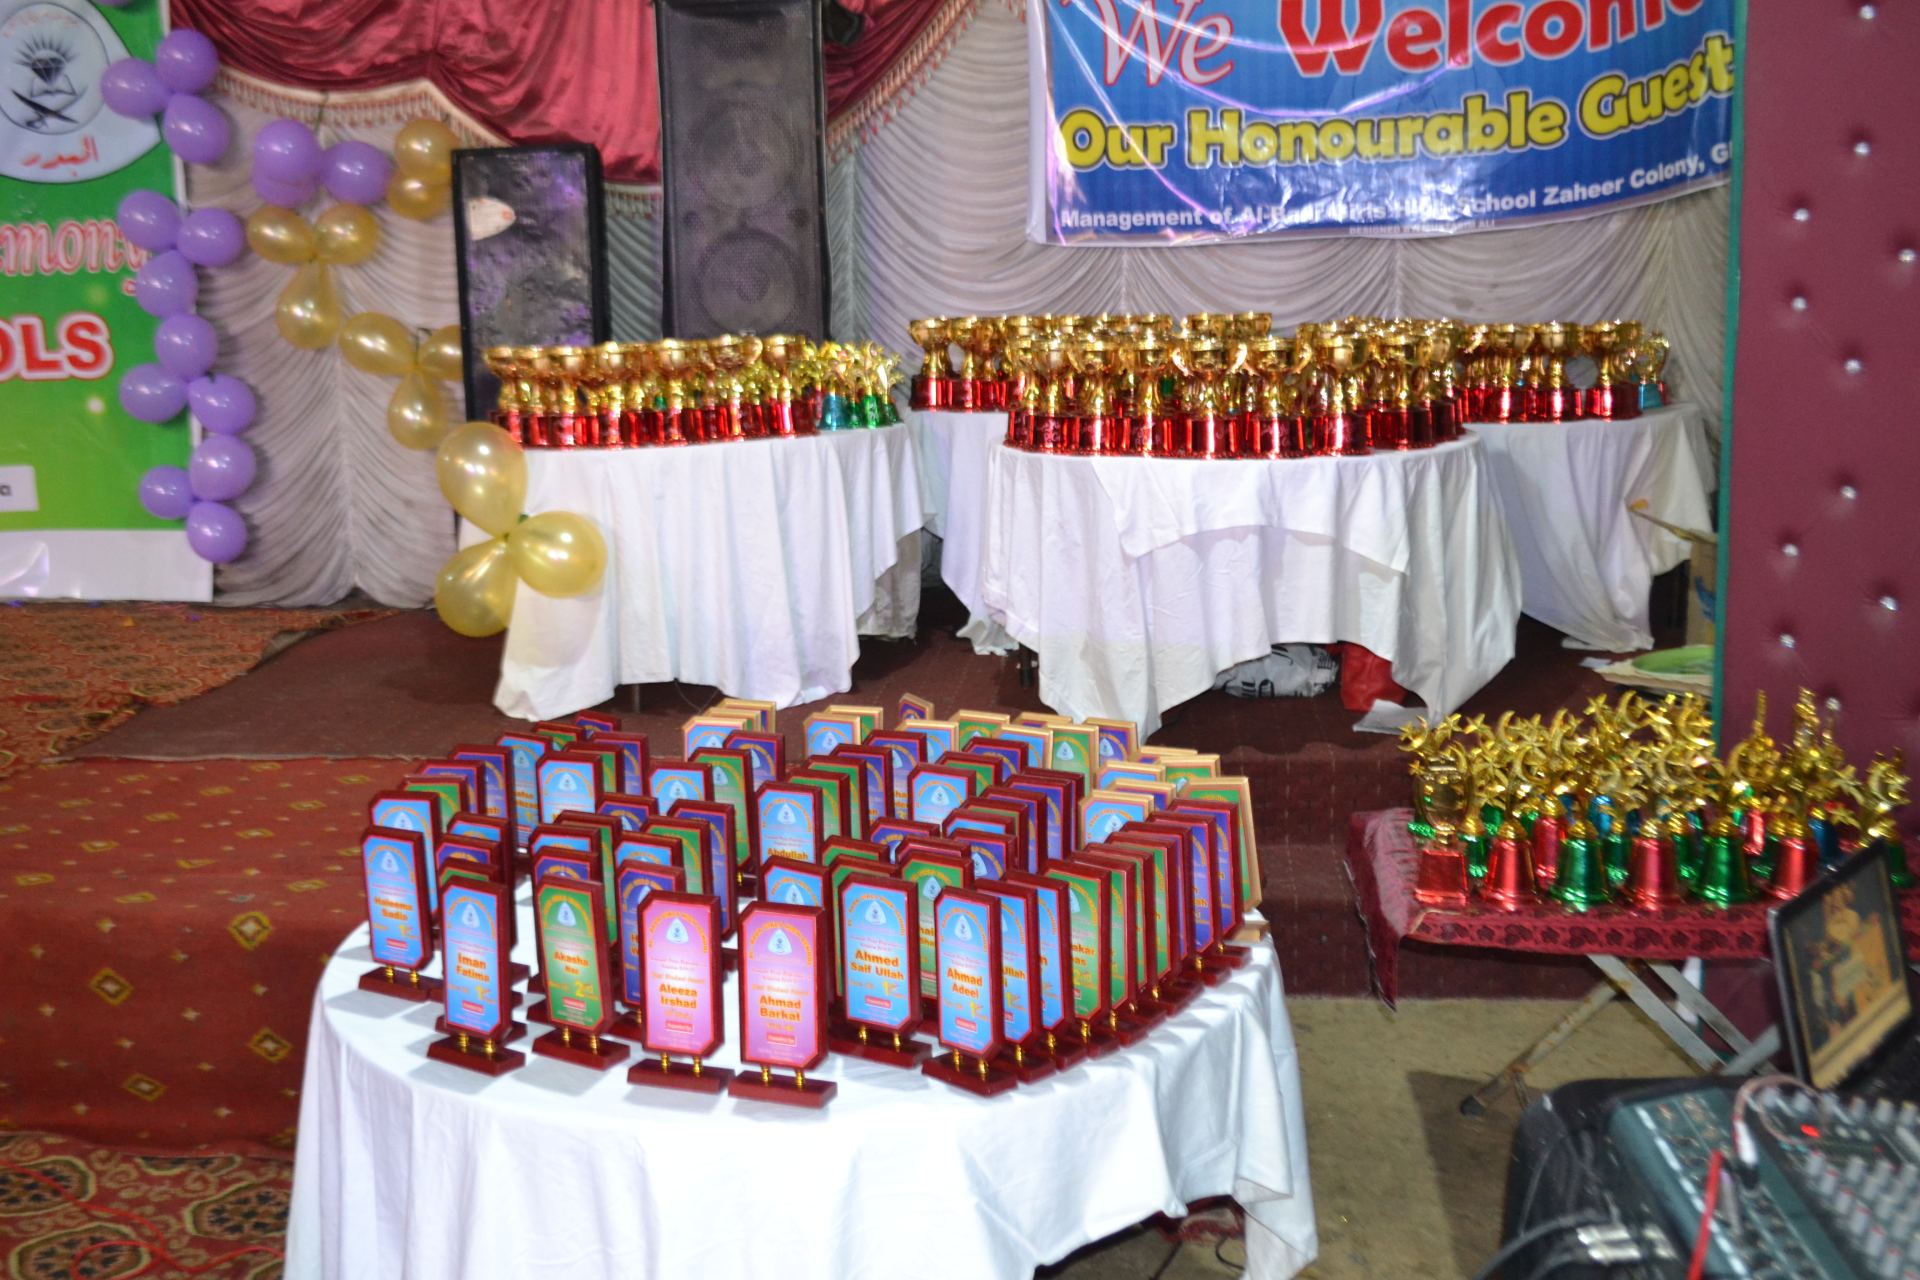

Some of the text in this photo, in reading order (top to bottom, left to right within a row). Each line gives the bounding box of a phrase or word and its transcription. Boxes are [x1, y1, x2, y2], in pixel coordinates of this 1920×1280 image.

[1062, 0, 1703, 87] We Welcom
[1056, 107, 1176, 170] Our
[1185, 88, 1569, 169] Honourable
[1061, 206, 1202, 230] Management
[1209, 207, 1233, 226] of
[1458, 188, 1536, 215] School
[1543, 178, 1625, 206] Zaheer
[1629, 154, 1705, 188] Colony,
[458, 953, 487, 970] Iman
[855, 949, 900, 968] Ahmed
[875, 965, 905, 981] Ullah
[946, 967, 983, 987] Ahmad
[659, 982, 698, 998] Aleeza
[660, 994, 698, 1010] Irshad
[759, 994, 802, 1010] Ahmad
[760, 1006, 801, 1022] Barkat
